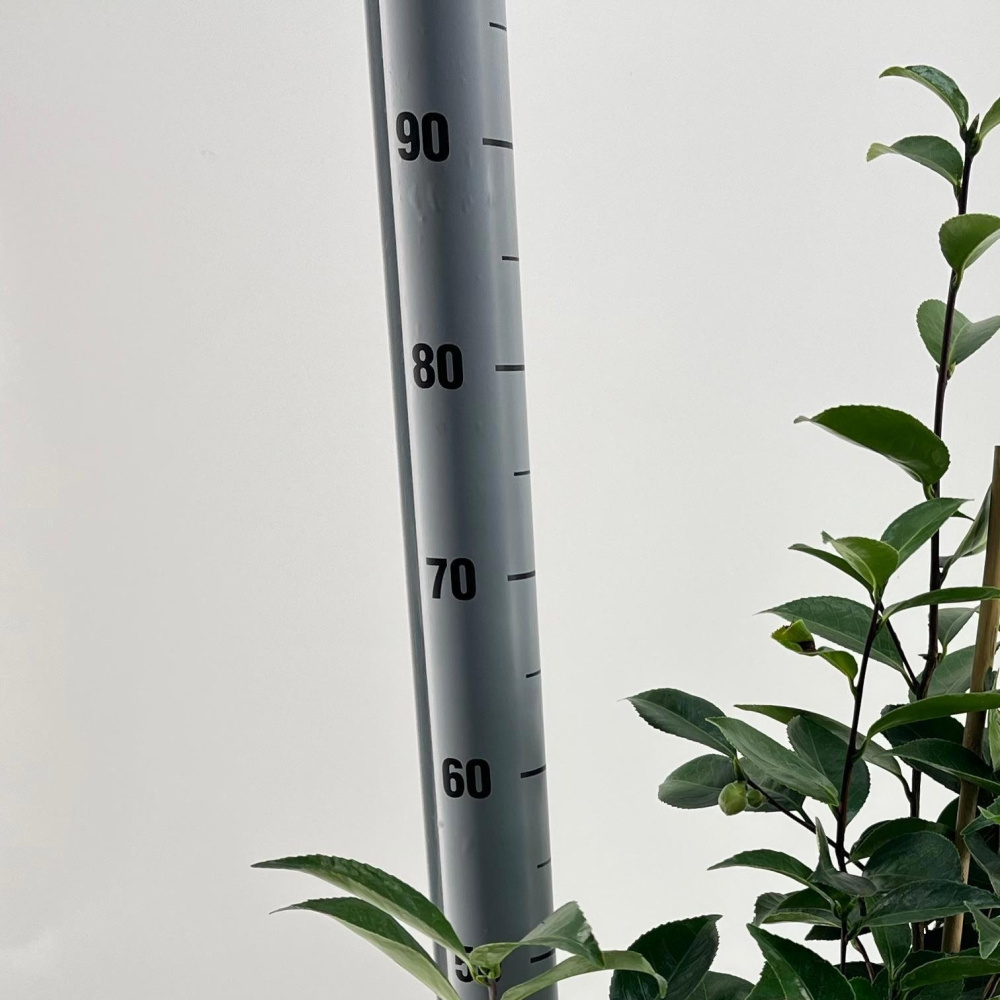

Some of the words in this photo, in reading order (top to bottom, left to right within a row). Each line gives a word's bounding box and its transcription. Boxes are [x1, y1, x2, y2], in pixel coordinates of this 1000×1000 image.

[395, 111, 450, 162] 90
[411, 343, 464, 390] 80
[426, 557, 477, 601] 70
[442, 757, 492, 799] 60
[455, 946, 502, 983] 5
